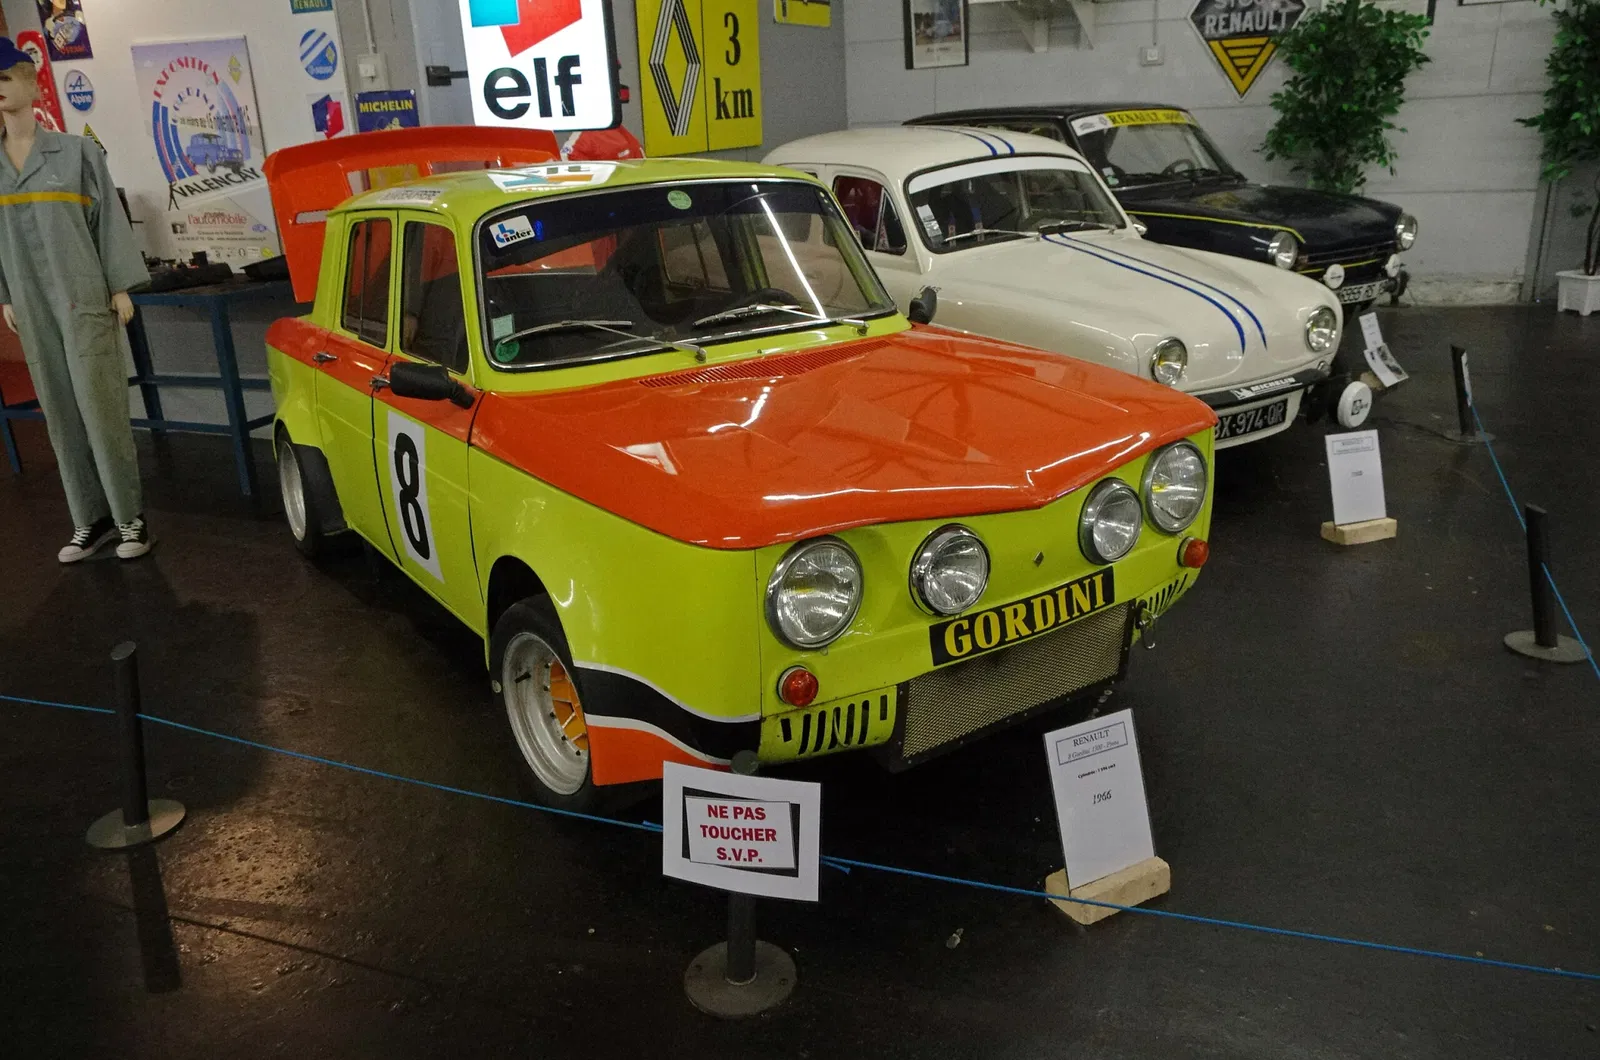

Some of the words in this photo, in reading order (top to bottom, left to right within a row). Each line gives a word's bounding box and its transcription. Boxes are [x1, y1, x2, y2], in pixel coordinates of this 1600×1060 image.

[1205, 10, 1287, 35] RENAULT
[724, 12, 741, 66] 3
[484, 54, 582, 120] elf
[71, 94, 92, 105] Alpine
[359, 100, 413, 112] MICHELIN
[713, 77, 754, 120] km
[1250, 377, 1296, 391] MICHELIN
[394, 432, 430, 560] 8
[944, 574, 1106, 657] GORDINI
[1073, 729, 1110, 747] RENAULT
[1093, 788, 1112, 804] 1966
[707, 804, 729, 818] NE
[733, 806, 766, 820] PAS
[700, 824, 777, 841] TOUCHER
[716, 847, 763, 862] S.V.P.
